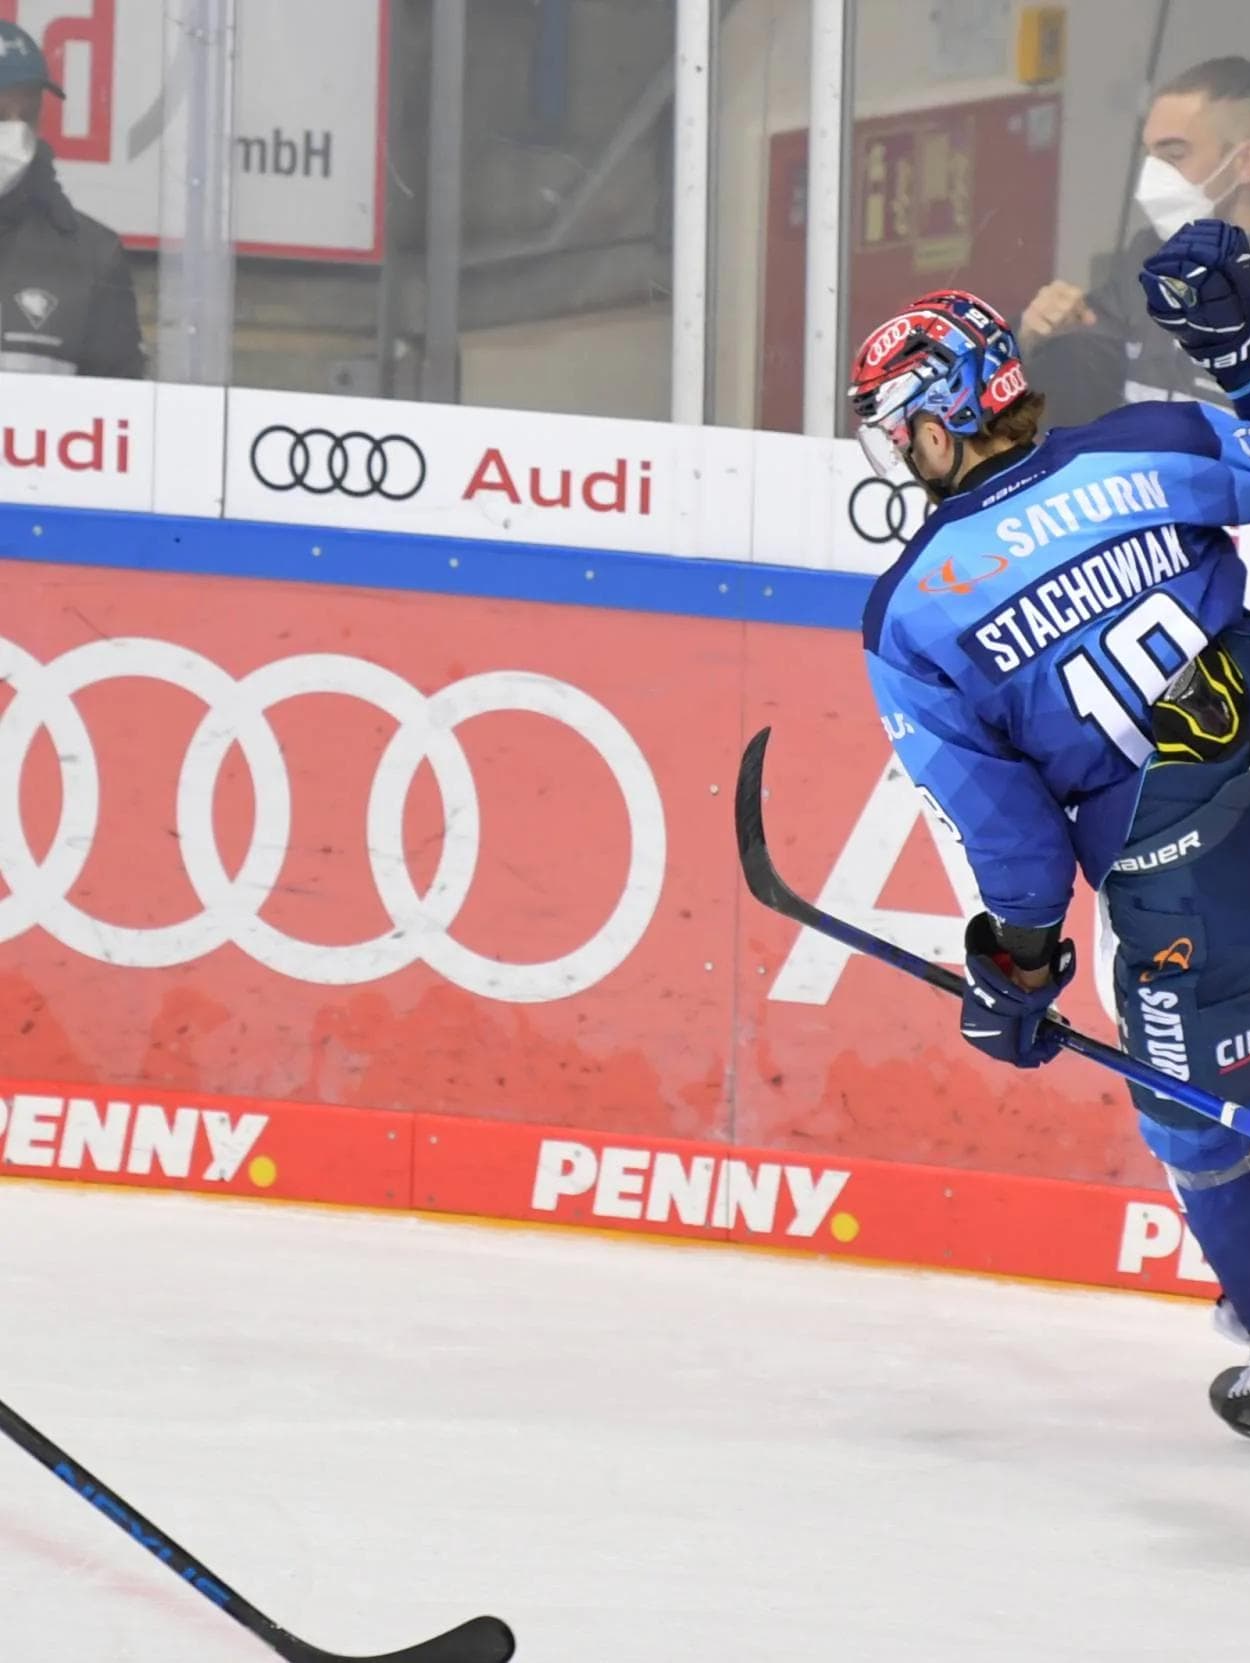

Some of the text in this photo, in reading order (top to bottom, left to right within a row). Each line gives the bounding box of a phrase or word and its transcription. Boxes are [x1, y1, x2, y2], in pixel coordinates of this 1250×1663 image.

[236, 127, 332, 179] mbH
[2, 417, 130, 474] udi
[462, 447, 653, 516] Audi
[996, 470, 1170, 558] SATURN
[976, 524, 1190, 673] STACHOWIAK
[1138, 987, 1191, 1100] SATUR
